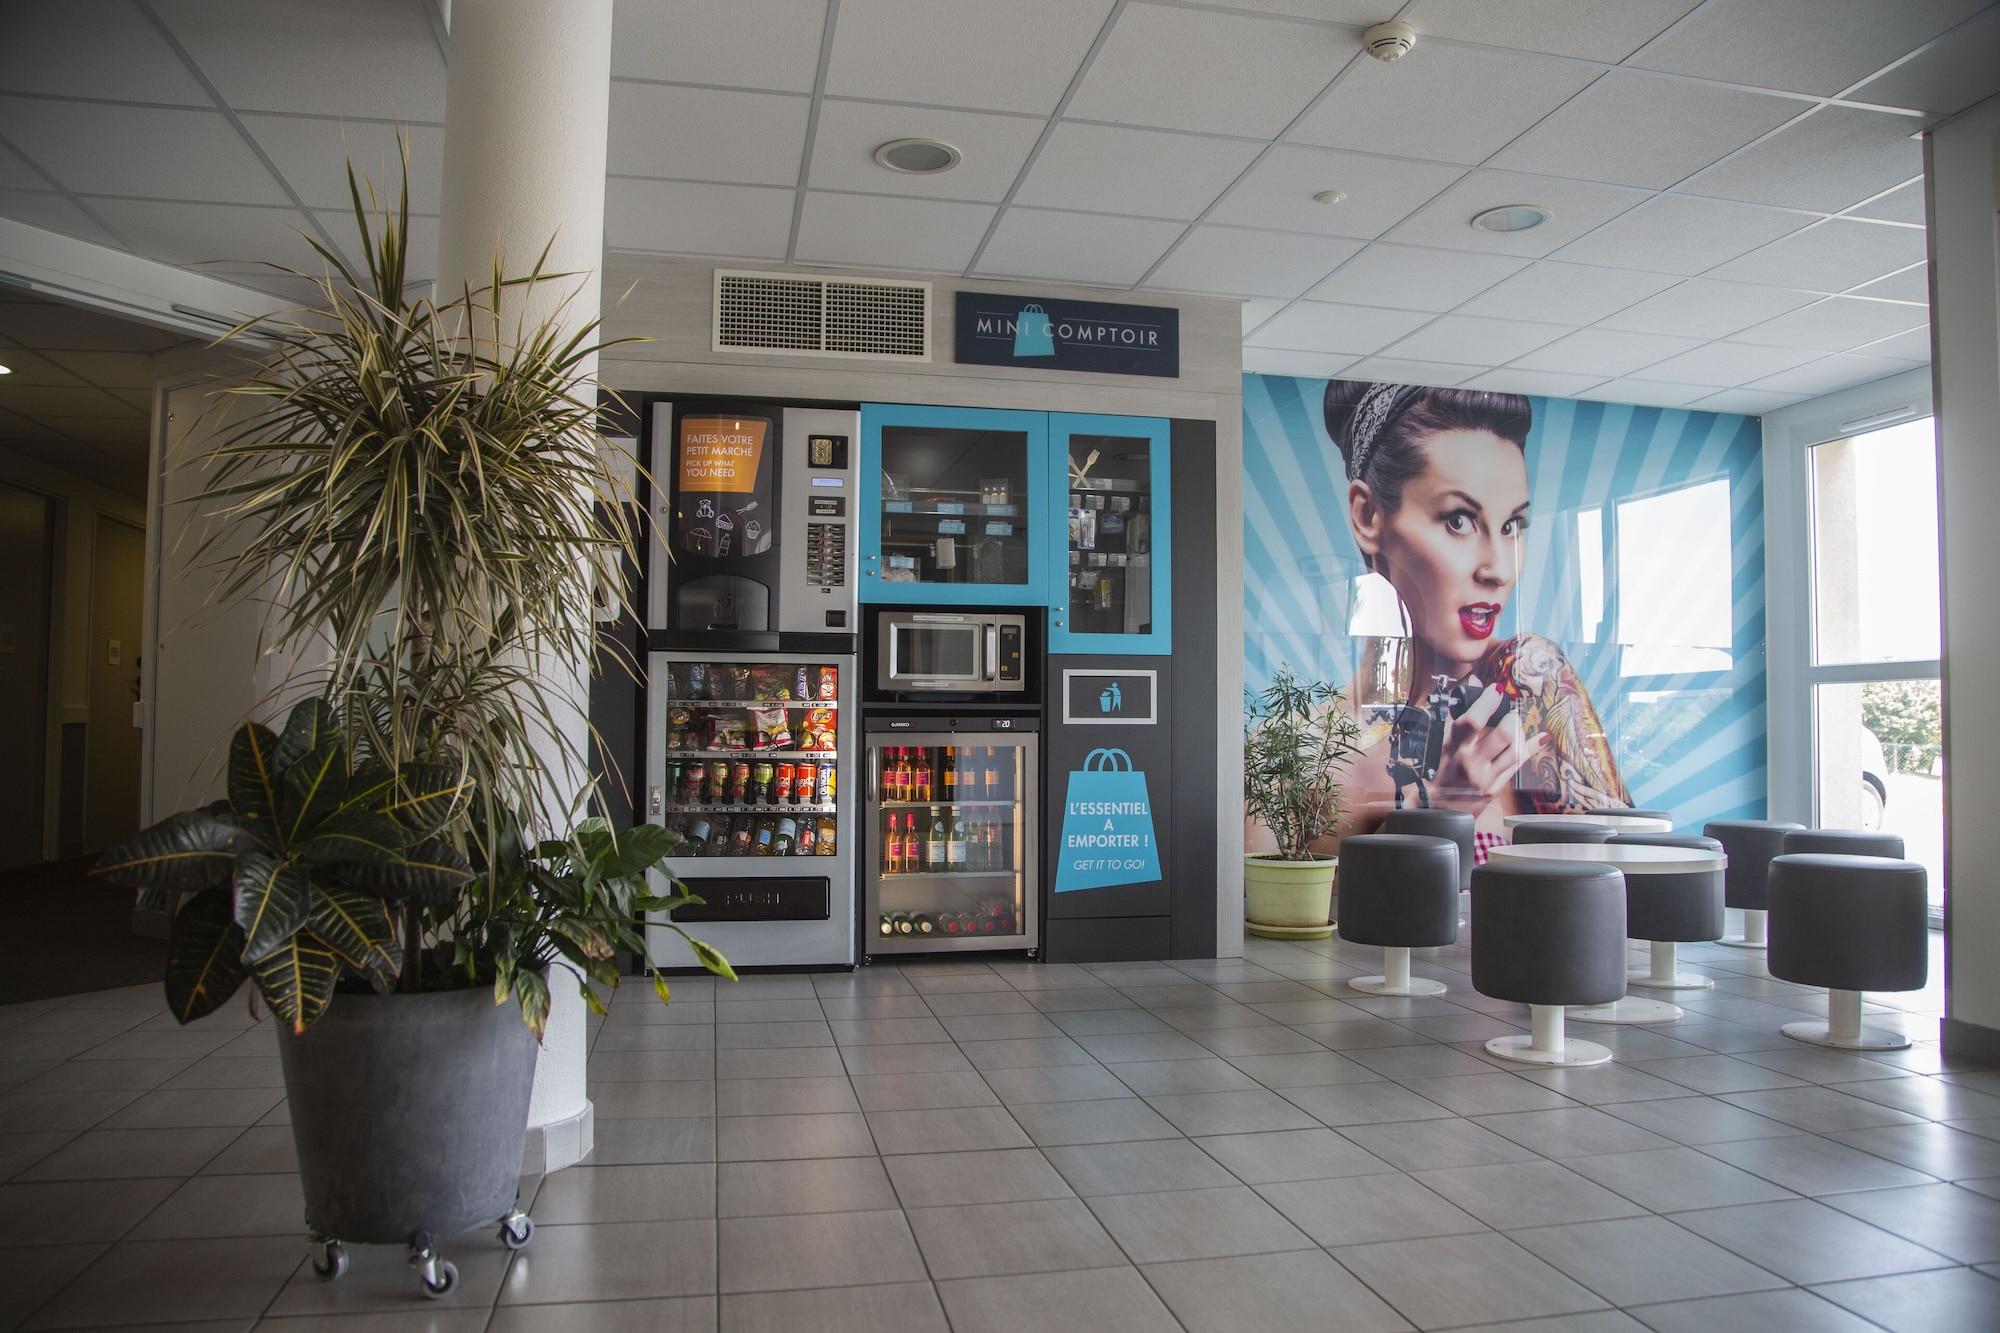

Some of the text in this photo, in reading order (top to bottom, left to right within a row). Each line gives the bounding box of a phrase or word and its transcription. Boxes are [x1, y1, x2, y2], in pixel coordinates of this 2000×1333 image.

[976, 317, 1158, 346] MINI COMPTOIR
[687, 434, 753, 445] FAITES VOTRE
[686, 445, 753, 457] PETIT MARCHÉ
[686, 468, 735, 478] YOU NEED
[1070, 802, 1148, 816] L'ESSENTIEL
[1103, 818, 1114, 831] A
[1068, 834, 1139, 848] EMPORTER
[1073, 859, 1145, 870] GET IT TO GO!
